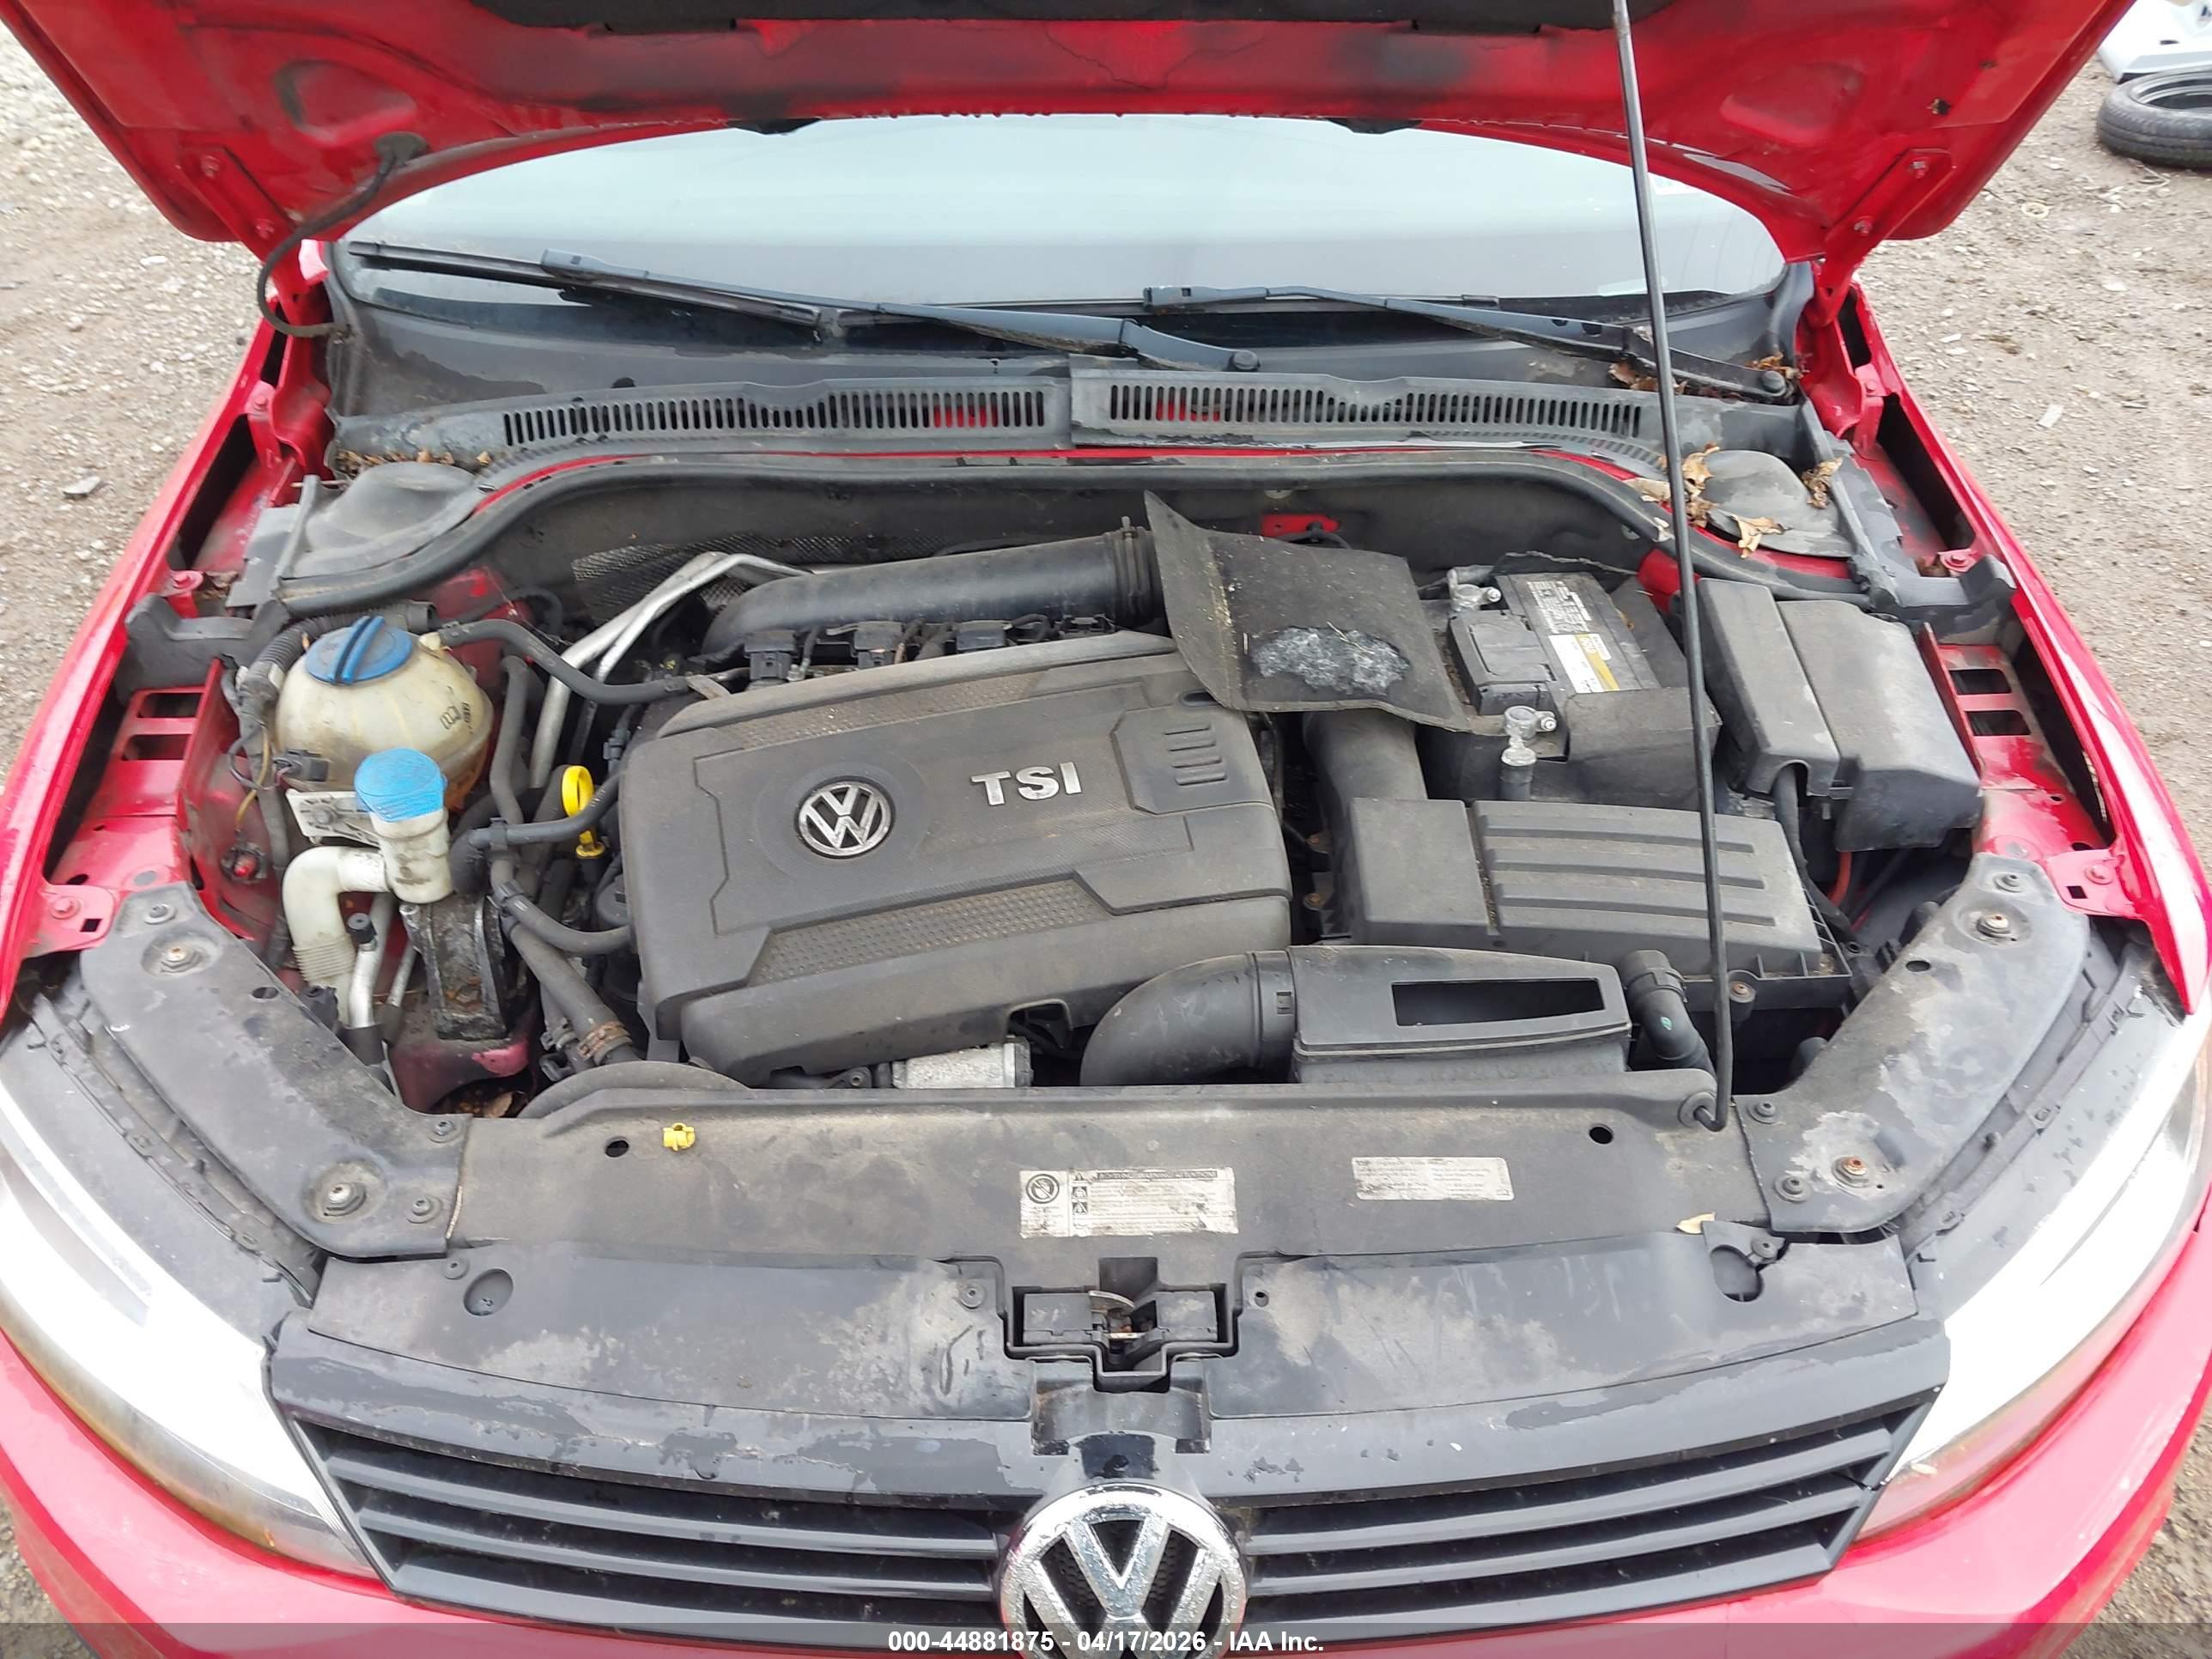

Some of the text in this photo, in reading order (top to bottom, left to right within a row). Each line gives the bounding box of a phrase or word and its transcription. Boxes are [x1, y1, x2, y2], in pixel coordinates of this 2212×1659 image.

[797, 778, 892, 857] VW
[970, 762, 1082, 805] TSI
[1000, 1486, 1246, 1659] VW
